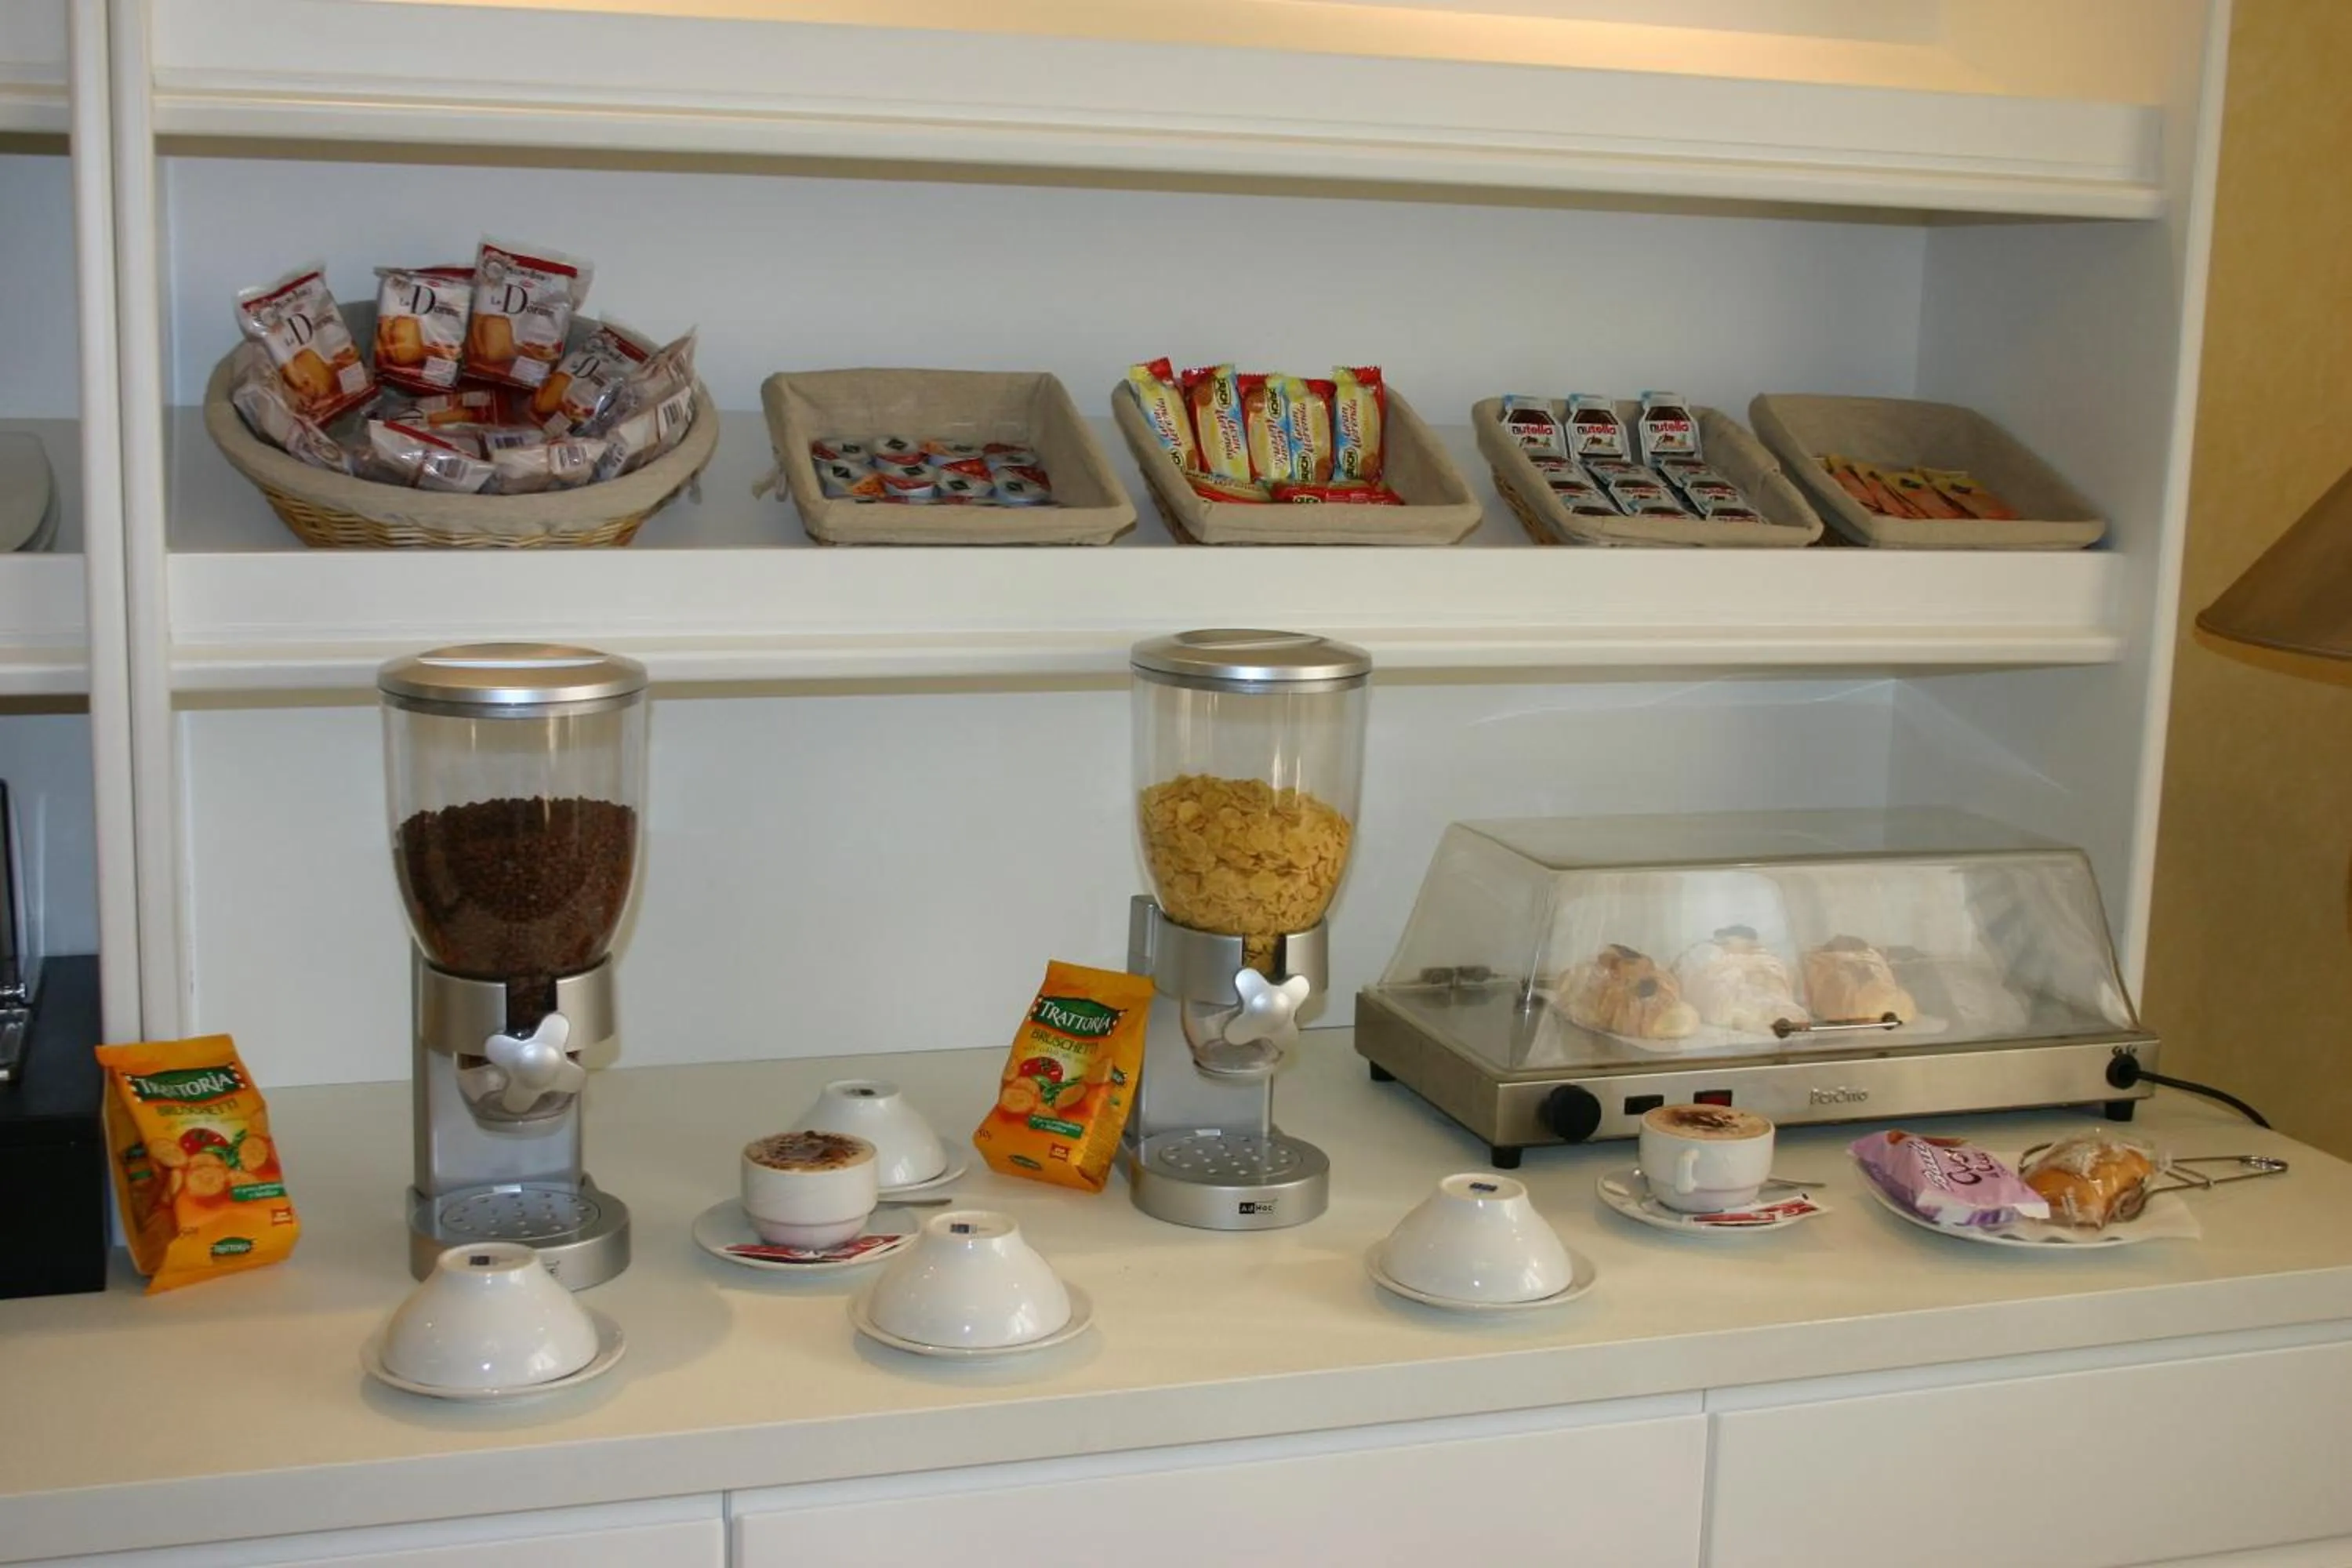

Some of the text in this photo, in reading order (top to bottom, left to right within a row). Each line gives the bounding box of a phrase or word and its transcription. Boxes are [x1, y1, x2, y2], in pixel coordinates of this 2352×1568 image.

[1512, 423, 1553, 436] nutella
[1577, 423, 1617, 436] nutella
[1649, 418, 1689, 433] nutella
